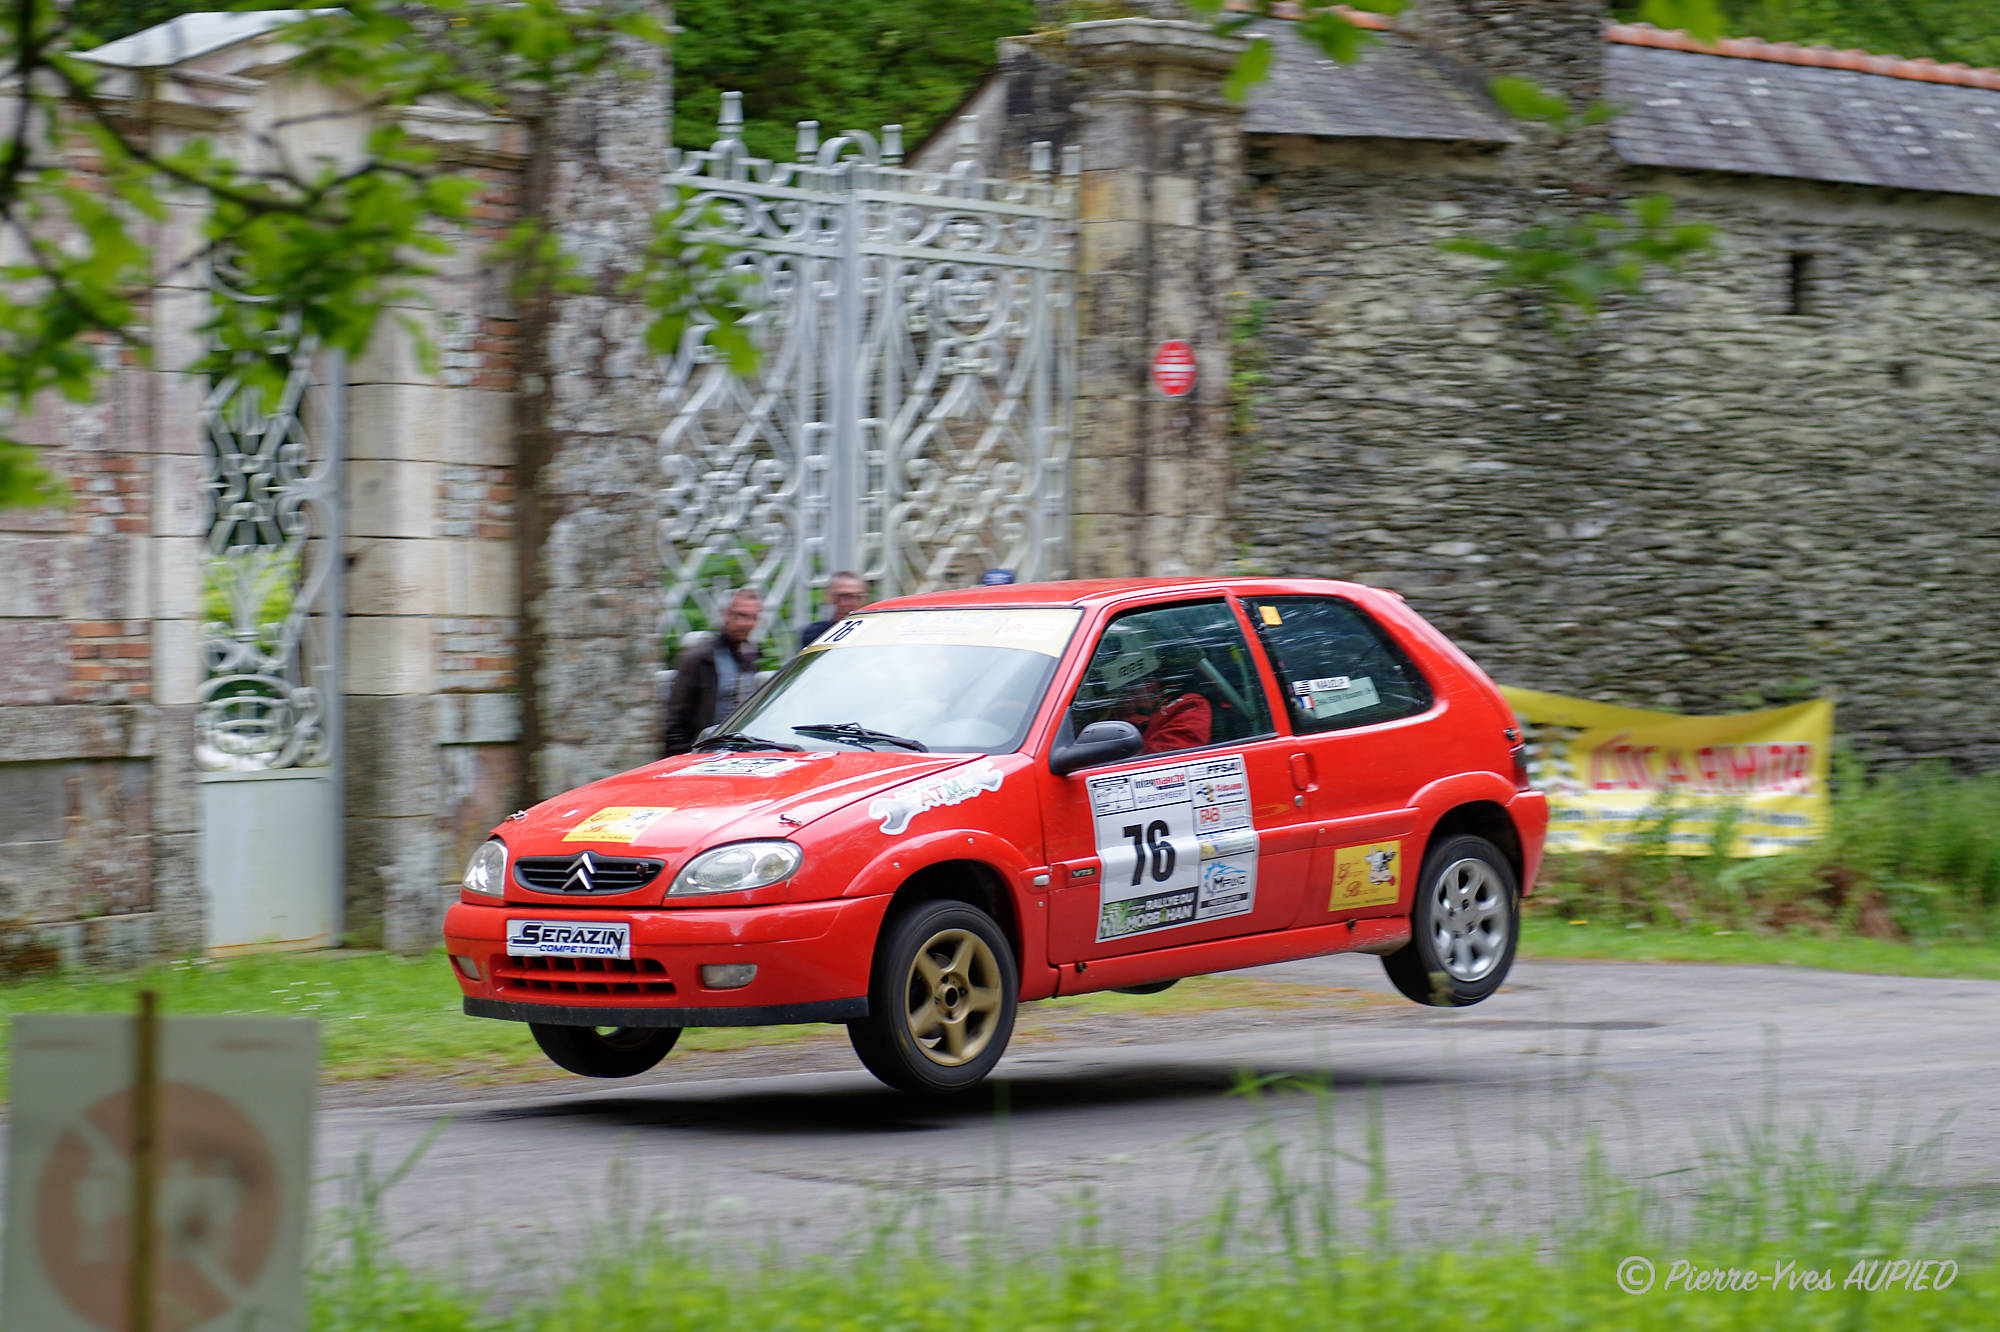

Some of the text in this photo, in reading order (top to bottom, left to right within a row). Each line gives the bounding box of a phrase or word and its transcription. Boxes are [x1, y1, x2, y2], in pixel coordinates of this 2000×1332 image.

[824, 620, 863, 642] 76
[1207, 762, 1236, 775] FFSA
[1123, 819, 1176, 886] 76
[1072, 867, 1094, 877] VTS
[1144, 895, 1180, 911] RALLYE
[511, 923, 625, 954] SERAZIN
[539, 944, 616, 955] COMPETITION
